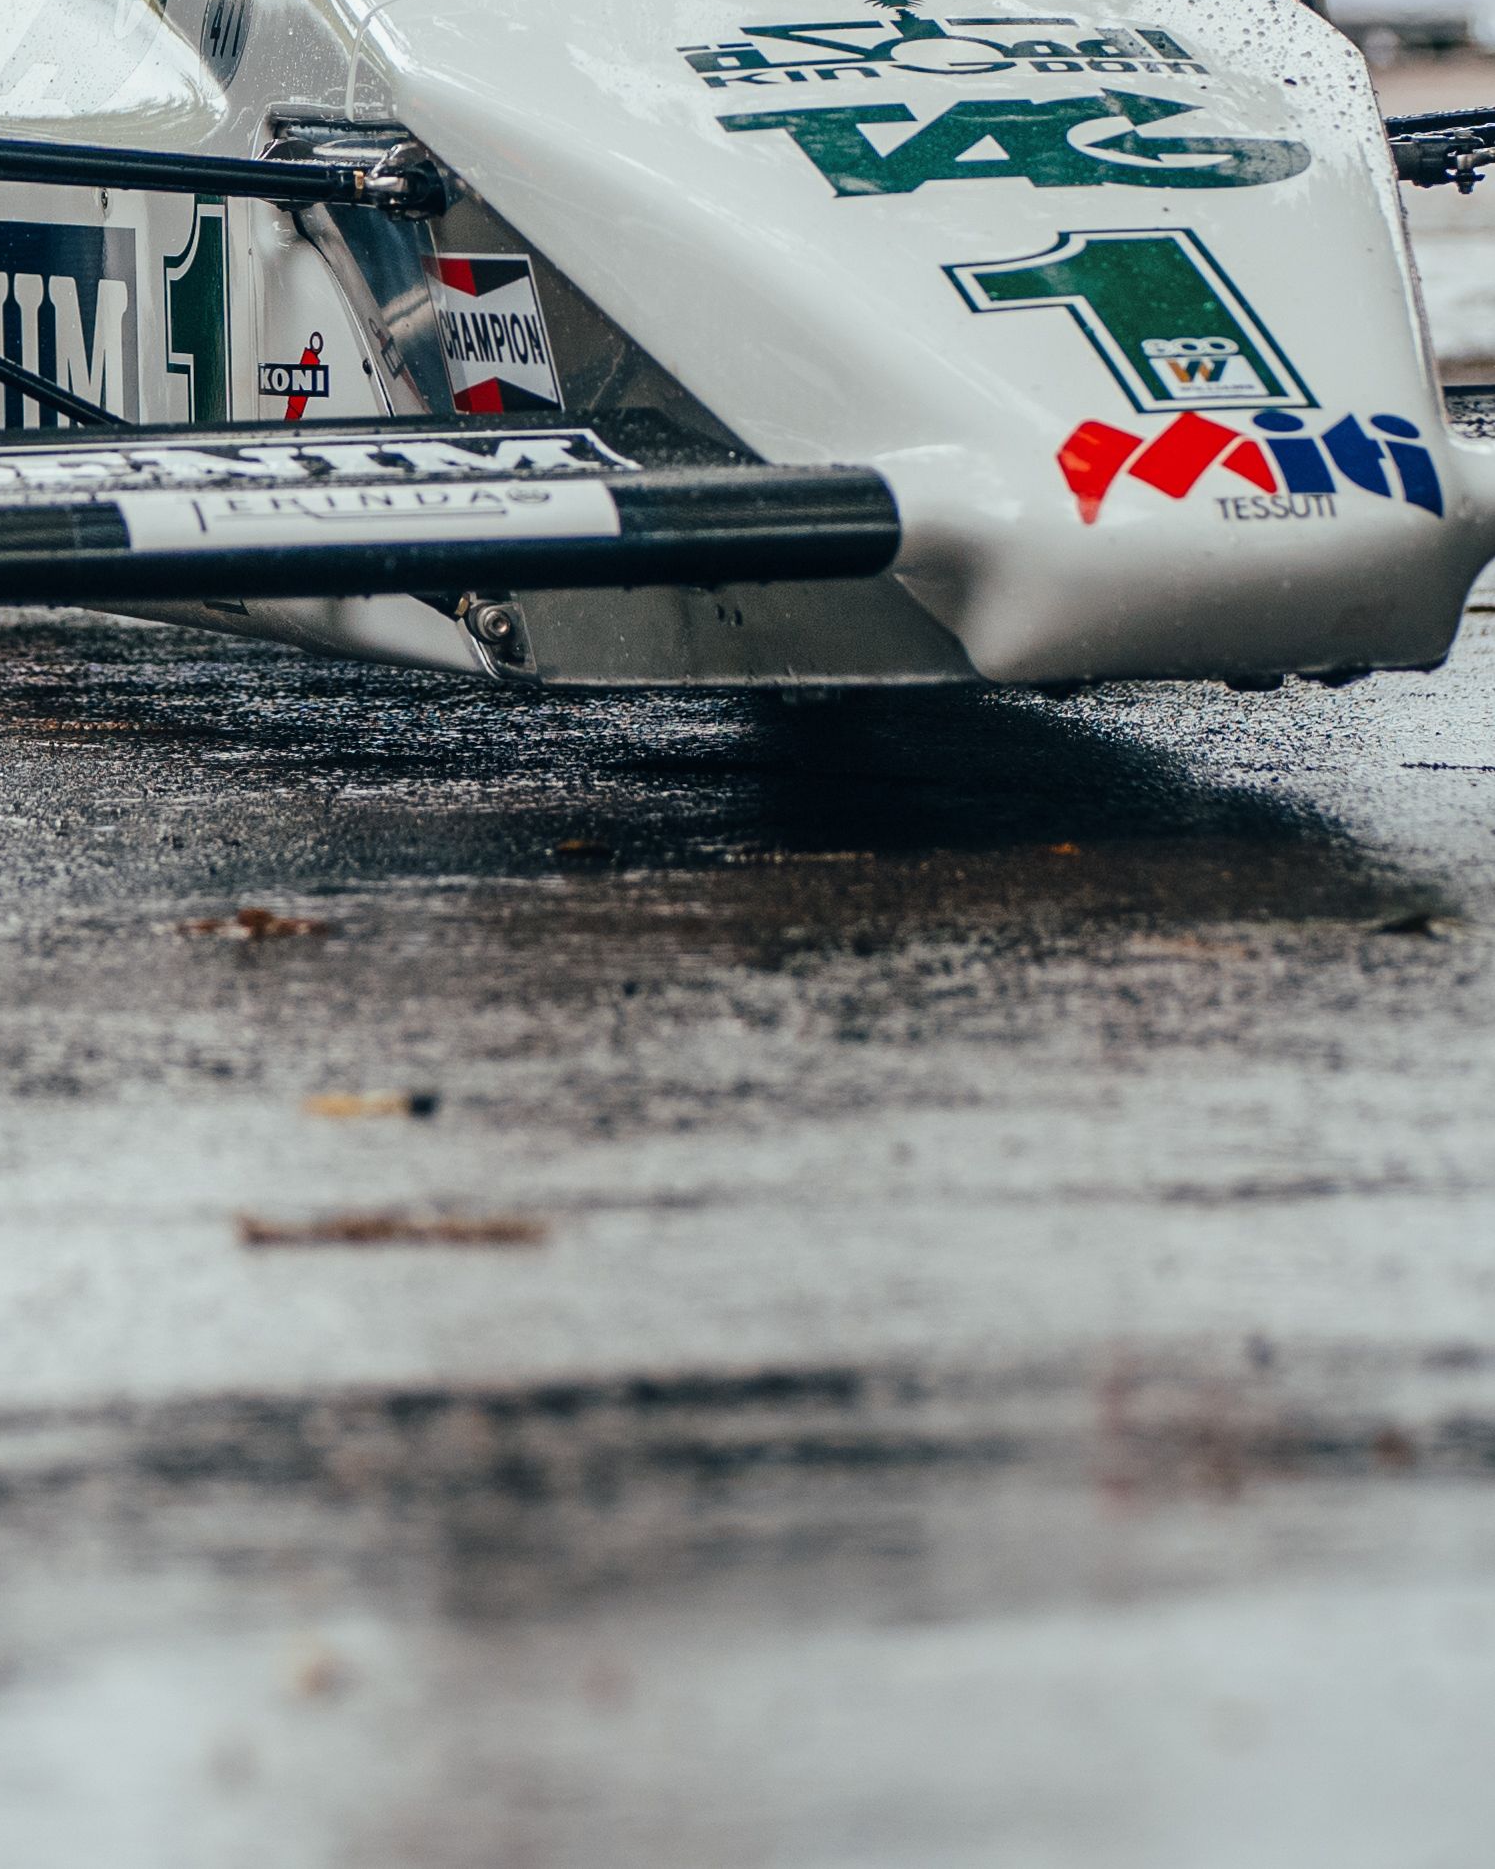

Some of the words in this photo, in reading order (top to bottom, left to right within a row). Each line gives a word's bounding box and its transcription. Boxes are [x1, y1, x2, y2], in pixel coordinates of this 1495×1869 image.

[716, 88, 1311, 197] TAG
[438, 308, 546, 365] CHAMPION
[940, 227, 1322, 414] 1
[260, 367, 325, 392] KONI
[1215, 494, 1337, 521] TESSUTI
